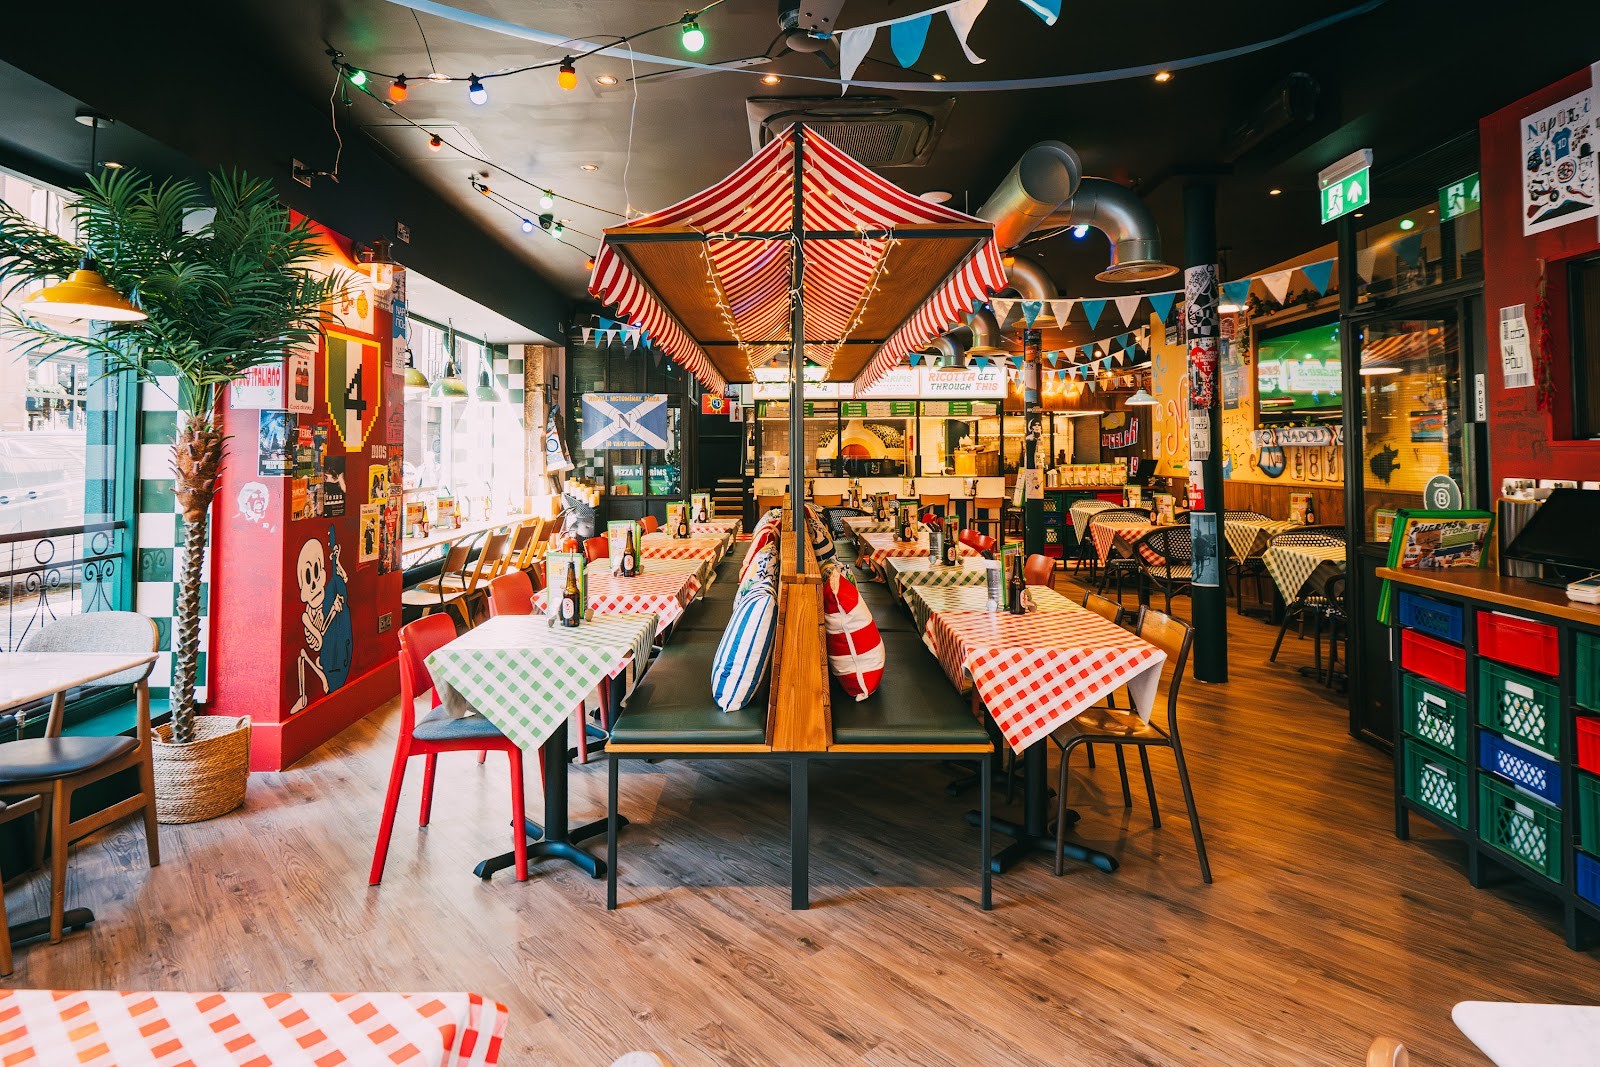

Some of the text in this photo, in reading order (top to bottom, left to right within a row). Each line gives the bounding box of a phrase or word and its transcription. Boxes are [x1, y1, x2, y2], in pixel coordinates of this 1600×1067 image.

[1557, 137, 1567, 150] 10
[252, 367, 280, 387] ITALIANO
[929, 372, 996, 382] RICOTTA GET
[344, 364, 366, 420] 4
[931, 382, 998, 391] THROUGH THIS
[618, 413, 632, 429] N
[1281, 429, 1325, 443] NAPOLI
[635, 467, 667, 476] PIRIMS
[1438, 492, 1447, 505] B
